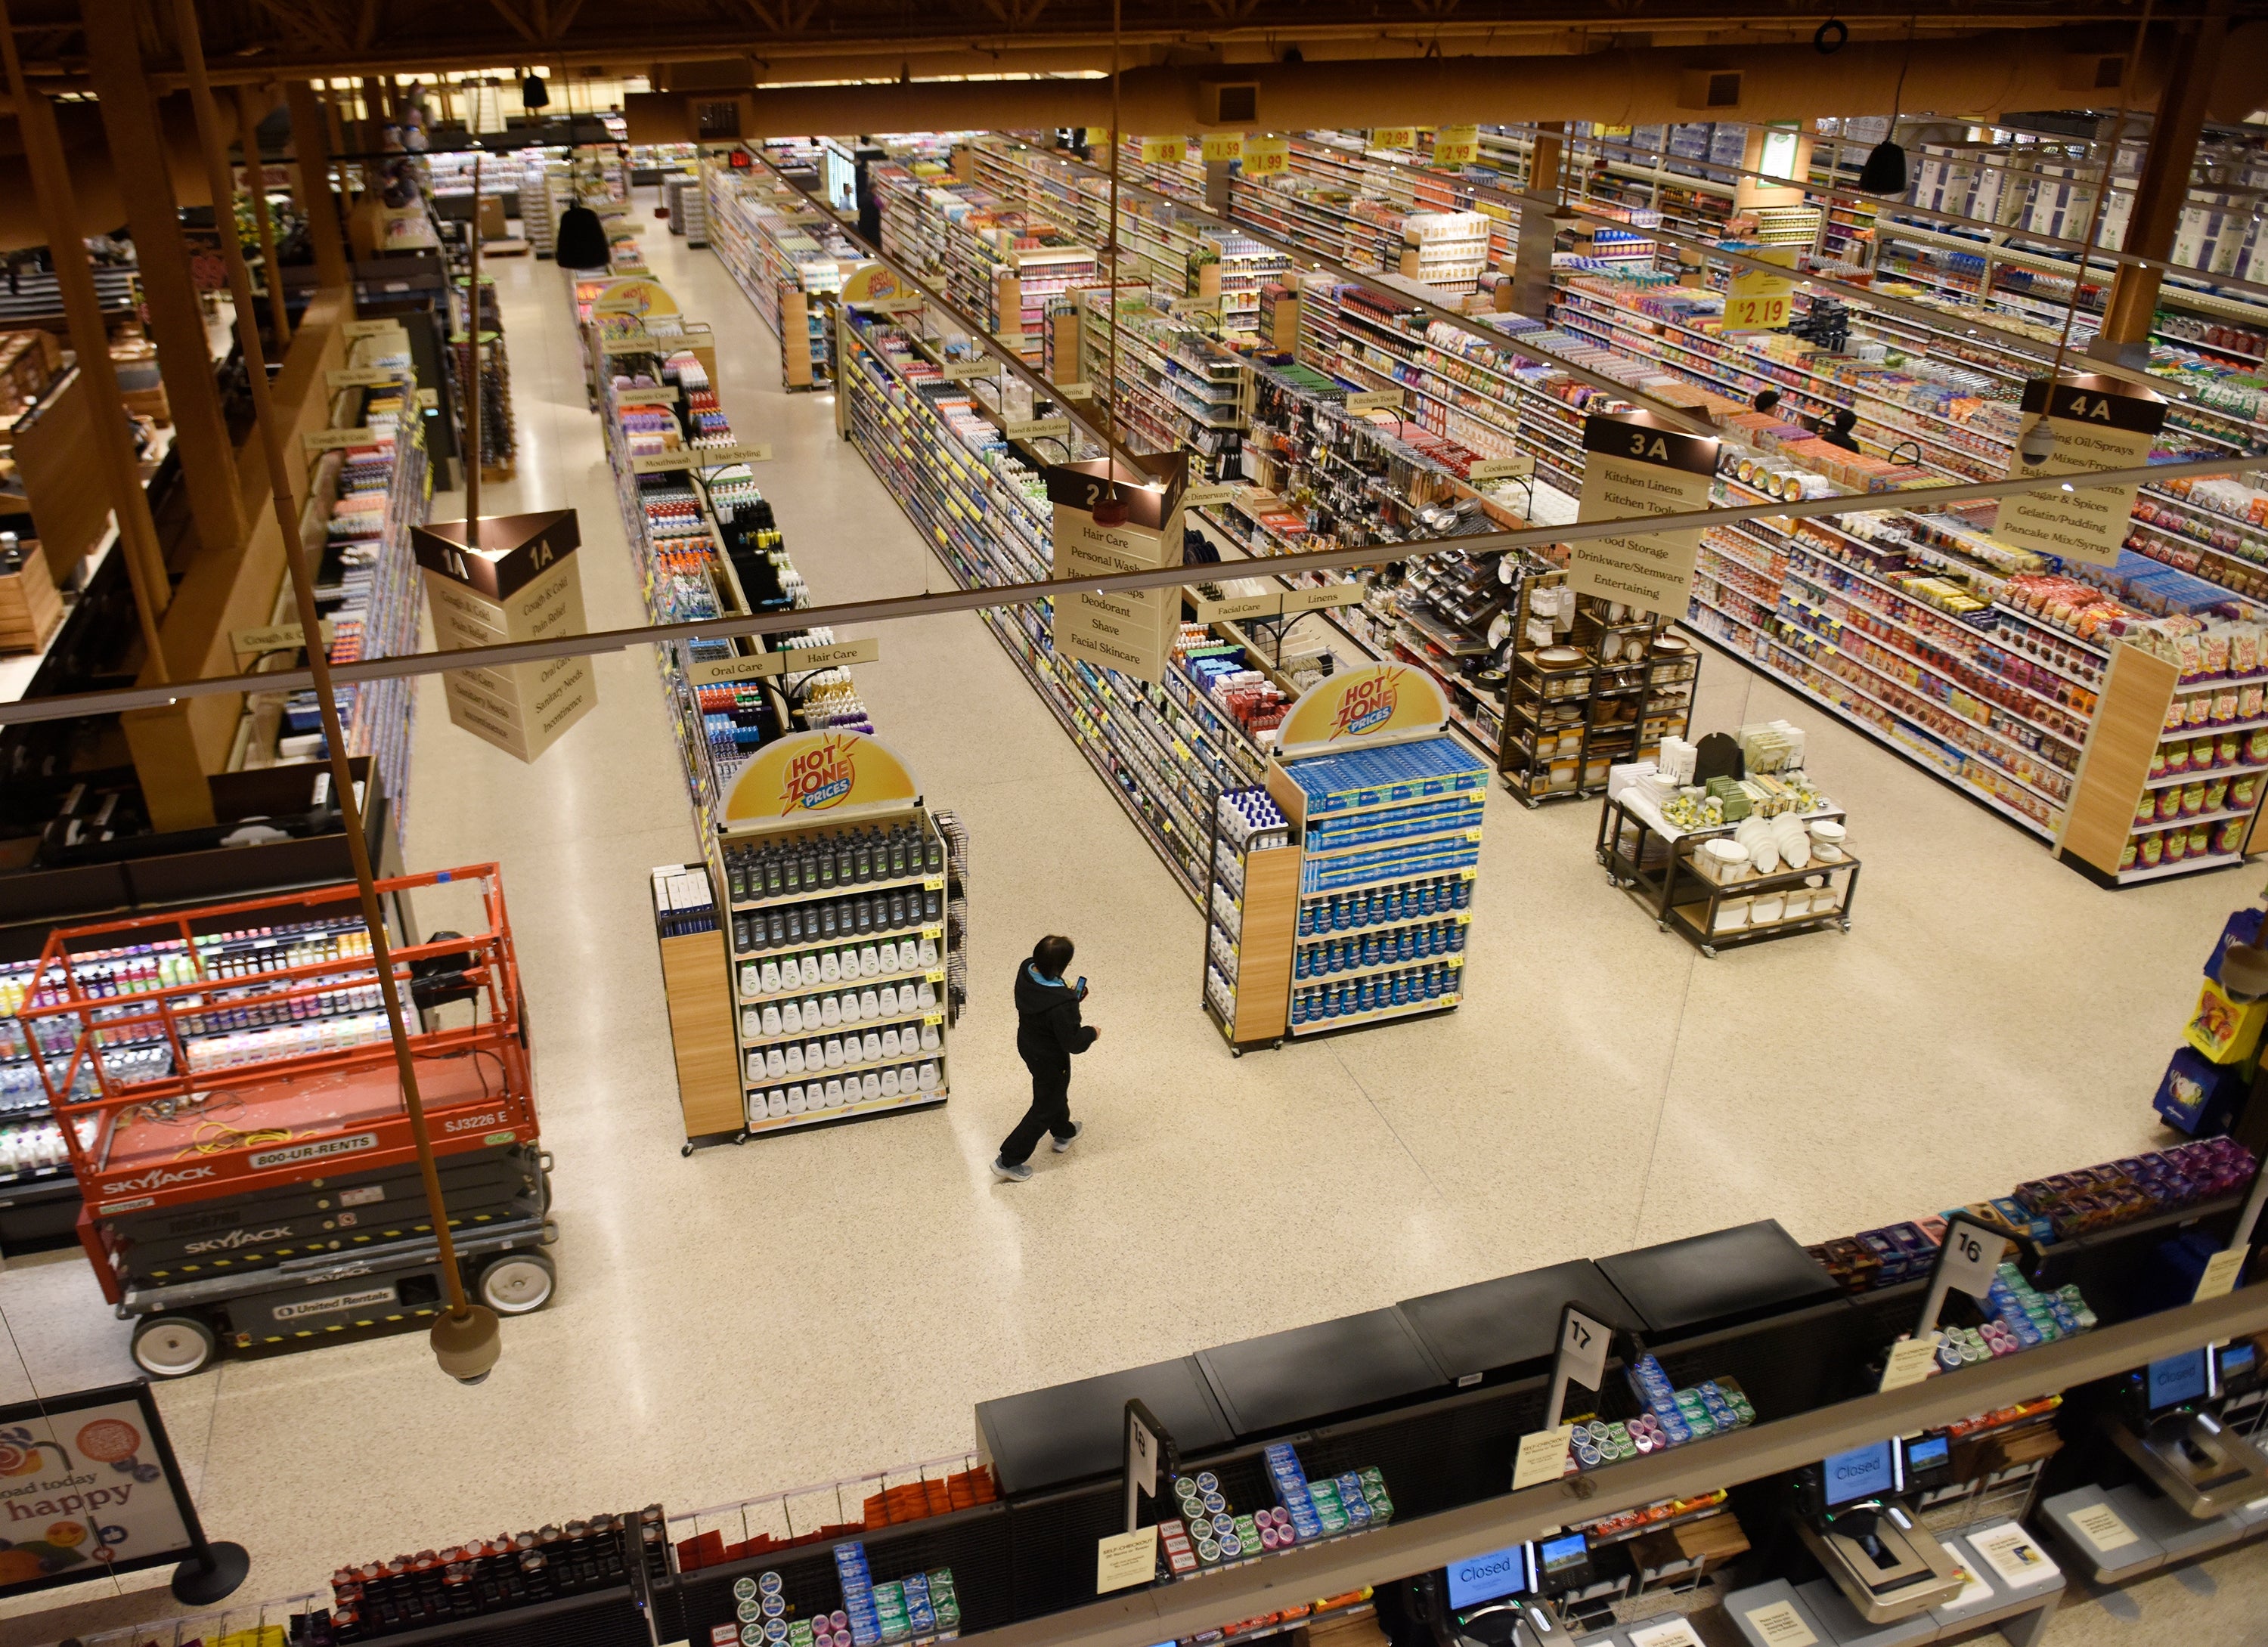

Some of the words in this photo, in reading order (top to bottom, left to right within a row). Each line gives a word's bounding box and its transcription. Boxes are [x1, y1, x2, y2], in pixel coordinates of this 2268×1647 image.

[1740, 300, 1783, 324] $2.19
[955, 367, 990, 376] Deodorant
[1353, 396, 1380, 405] Kitchen
[1381, 395, 1398, 404] Tools
[2069, 395, 2111, 422] 4A
[715, 451, 732, 461] Hair
[1629, 433, 1668, 462] 3A
[2074, 435, 2135, 457] Oil/Sprays
[645, 457, 692, 469] Mouthwash
[1483, 463, 1522, 473] Cookware
[1604, 470, 1645, 488] Kitchen
[1647, 479, 1684, 497] Linens
[1191, 491, 1231, 502] Dinnerware
[1603, 491, 1644, 510] Kitchen
[2072, 497, 2108, 514] Spices
[2017, 506, 2107, 534] Gelatin/Pudding
[1083, 527, 1103, 541] Hair
[1106, 533, 1129, 549] Care
[1627, 538, 1669, 560] Storage
[2004, 522, 2050, 540] Pancake
[2053, 532, 2111, 555] Mix/Syrup
[529, 539, 554, 571] 1A
[1071, 546, 1112, 567] Personal
[1114, 558, 1141, 572] Wash
[1577, 550, 1685, 585] Drinkware/Stemware
[1307, 593, 1339, 604] Linens
[1594, 573, 1661, 601] Entertaining
[1081, 593, 1132, 618] Deodorant
[1218, 605, 1241, 615] Facial
[1242, 602, 1261, 613] Care
[532, 618, 549, 636] Pain
[549, 602, 567, 625] Relief
[1092, 618, 1120, 636] Shave
[807, 650, 832, 664] Hair
[833, 648, 858, 661] Care
[1070, 633, 1097, 651] Facial
[1099, 642, 1141, 664] Skincare
[711, 664, 738, 677] Oral
[739, 661, 764, 675] Care
[535, 686, 563, 714] Sanitary
[563, 669, 584, 691] Needs
[1345, 676, 1387, 707] HOT
[544, 694, 583, 733] Incontinence
[1337, 687, 1395, 729] ZONE
[1350, 707, 1391, 733] PRICES
[792, 745, 836, 779] HOT
[786, 758, 850, 804] ZONE
[804, 780, 849, 806] PRICES
[445, 1113, 495, 1133] SJ3226
[497, 1111, 508, 1123] E
[257, 1136, 370, 1166] 800-UR-RENTS
[101, 1166, 217, 1195] SKYJACK
[184, 1225, 294, 1255] SKYJACK
[1958, 1232, 1981, 1263] 16
[296, 1299, 339, 1314] United
[342, 1289, 390, 1308] Rentals
[1572, 1319, 1591, 1350] 17
[41, 1472, 98, 1491] today
[1836, 1457, 1881, 1481] Closed
[3, 1484, 133, 1522] happy
[1235, 1519, 1253, 1531] Extra
[1102, 1538, 1154, 1556] SELF-CHECKOUT
[1241, 1535, 1259, 1548] Extra
[1461, 1557, 1511, 1583] Closed
[790, 1624, 810, 1638] Extra
